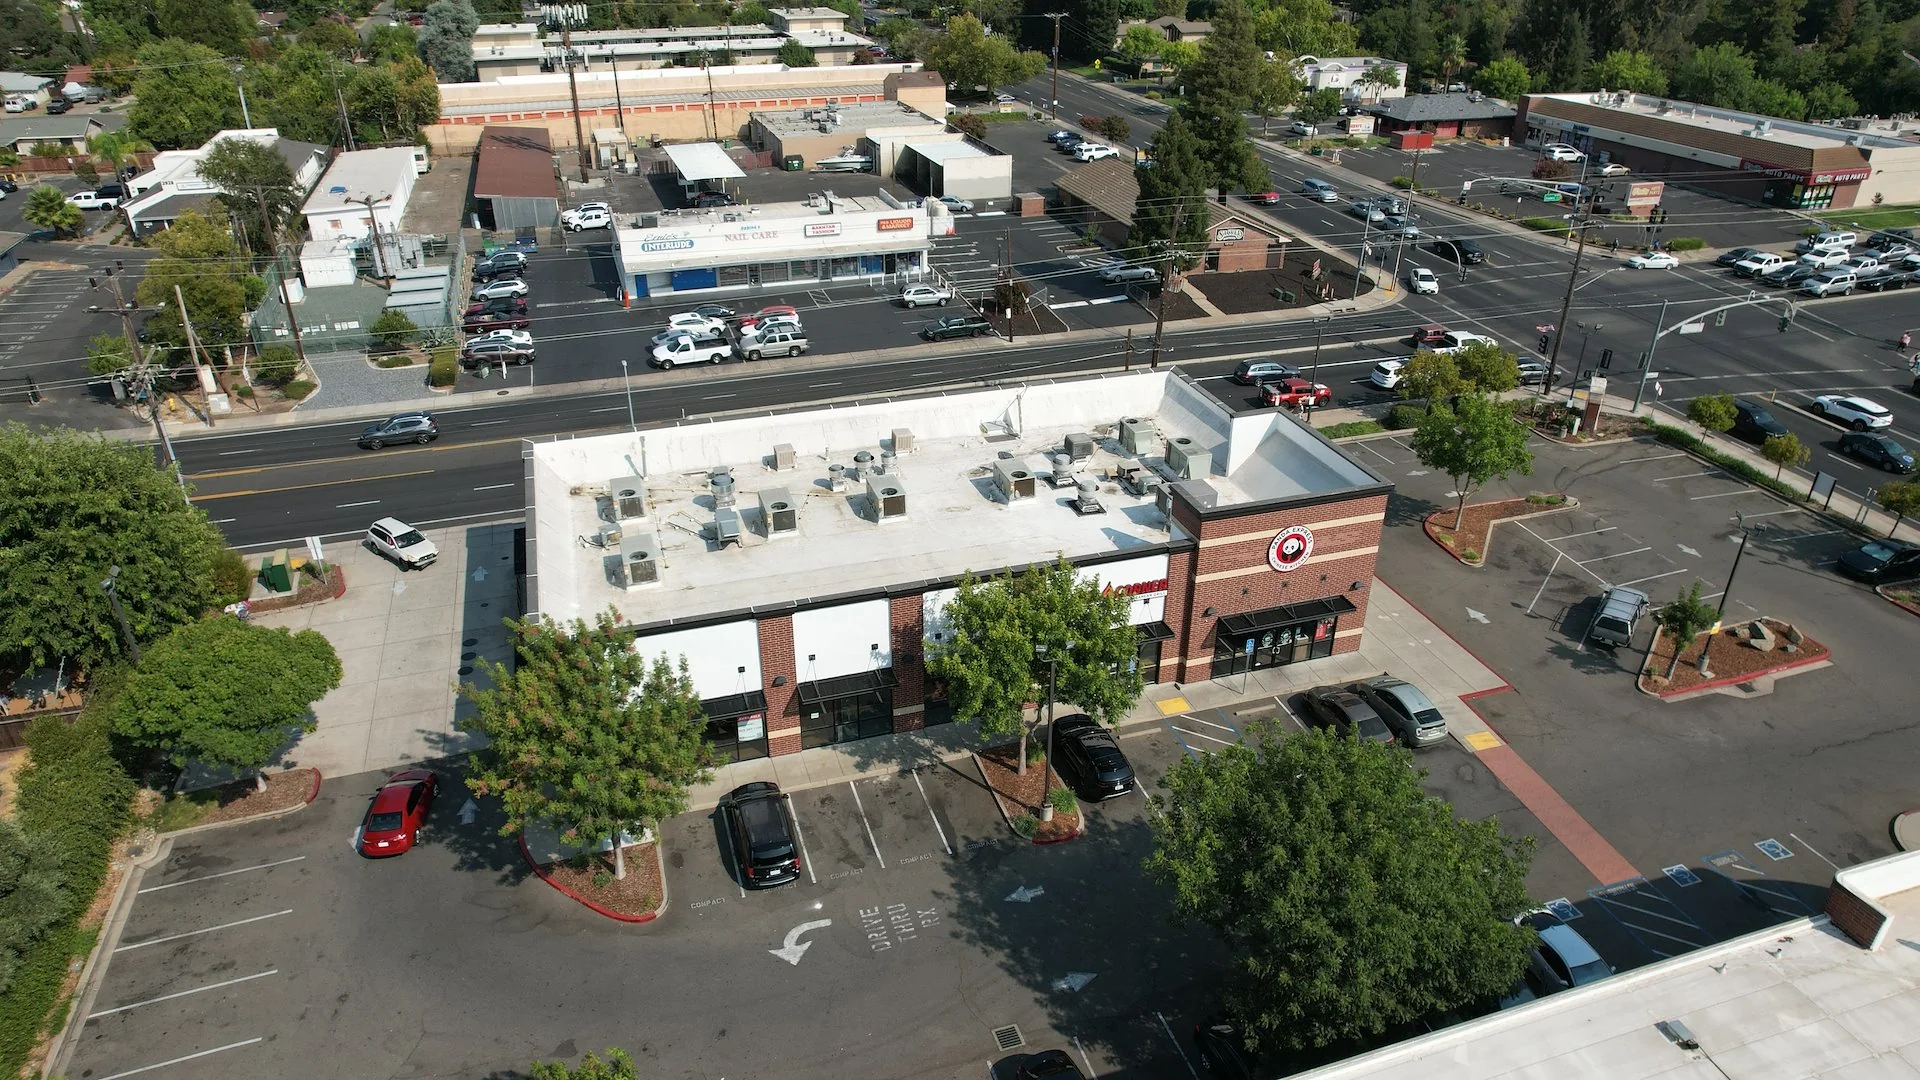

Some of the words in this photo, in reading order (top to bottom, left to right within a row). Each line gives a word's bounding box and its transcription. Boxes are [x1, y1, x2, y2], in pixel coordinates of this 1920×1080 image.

[724, 233, 749, 242] NAIL
[751, 231, 779, 240] CARE
[643, 240, 692, 252] INTERLUDE
[1271, 529, 1291, 550] PANDA
[1292, 527, 1313, 544] EXPRESS
[1114, 578, 1168, 598] CORNER
[900, 853, 933, 865] COMPACT
[830, 868, 864, 880] COMPACT
[690, 897, 726, 909] COMPACT
[859, 906, 892, 952] DRIVE
[886, 903, 917, 943] THRU
